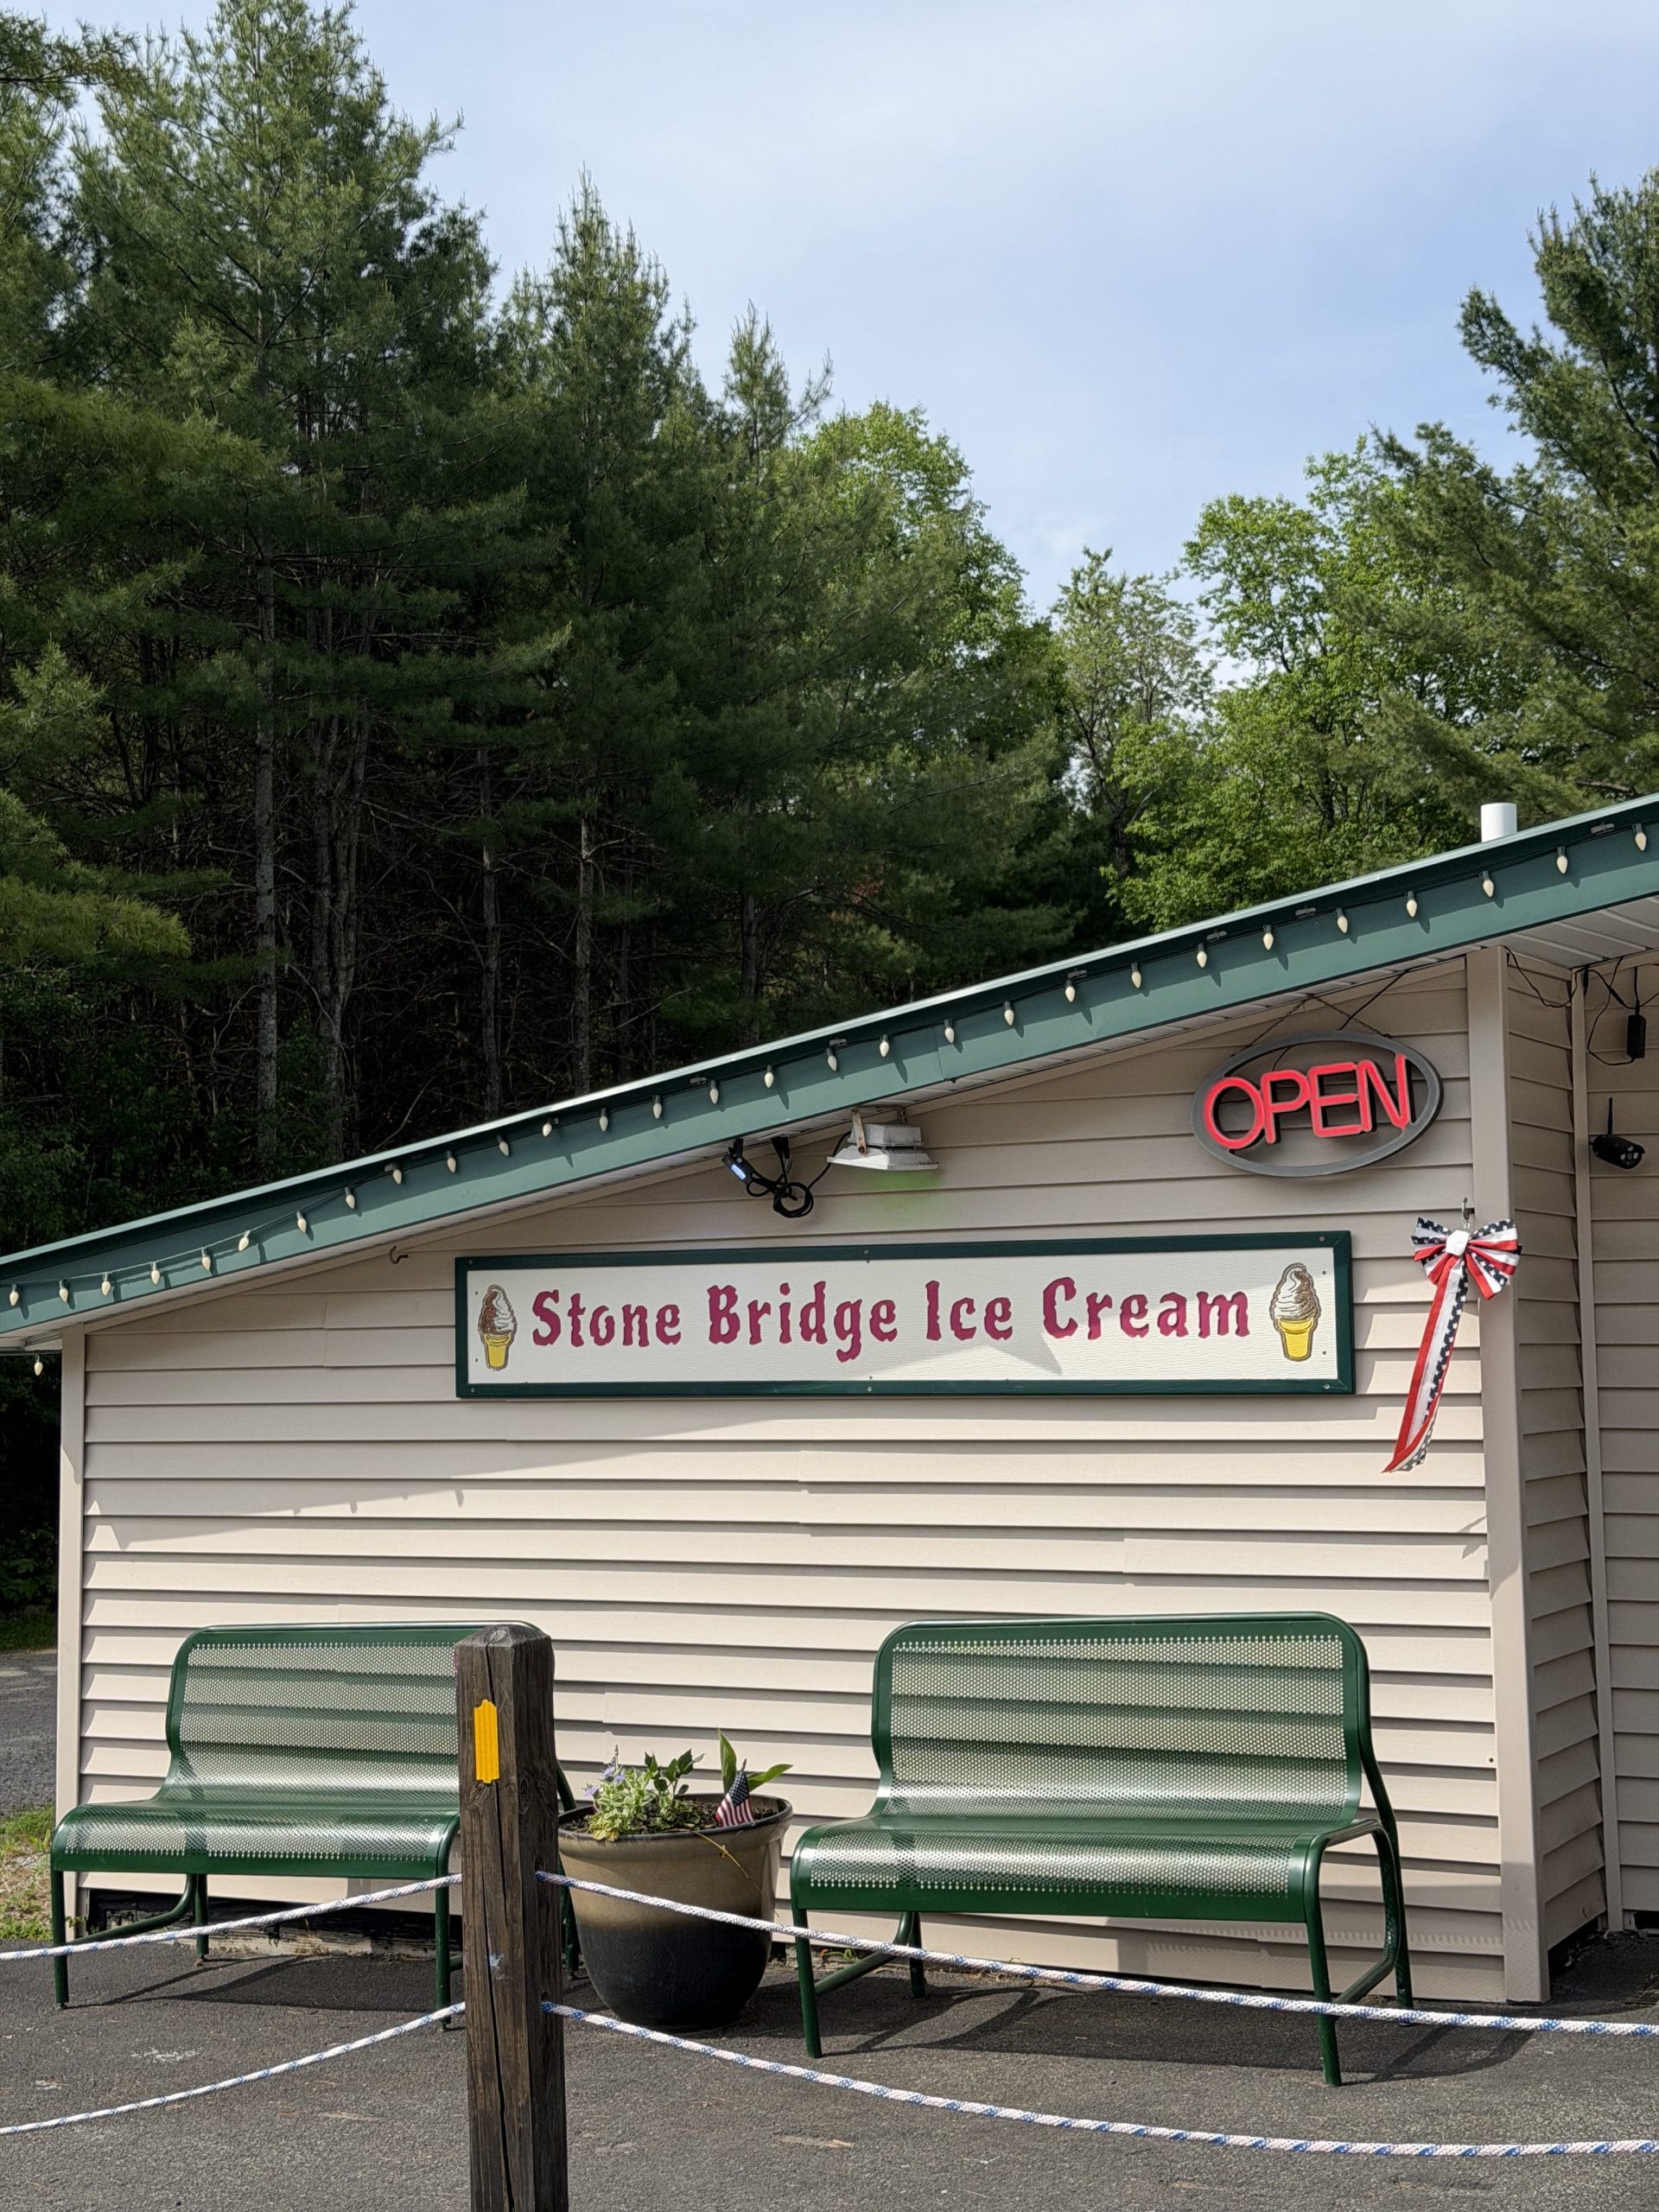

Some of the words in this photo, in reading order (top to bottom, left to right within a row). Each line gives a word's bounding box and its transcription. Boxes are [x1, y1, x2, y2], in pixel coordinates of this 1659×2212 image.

[1203, 1053, 1411, 1150] OPEN
[532, 1289, 682, 1348] Stone
[708, 1281, 897, 1363] Bridge
[925, 1281, 1013, 1340] Ice
[1043, 1276, 1249, 1340] Cream
